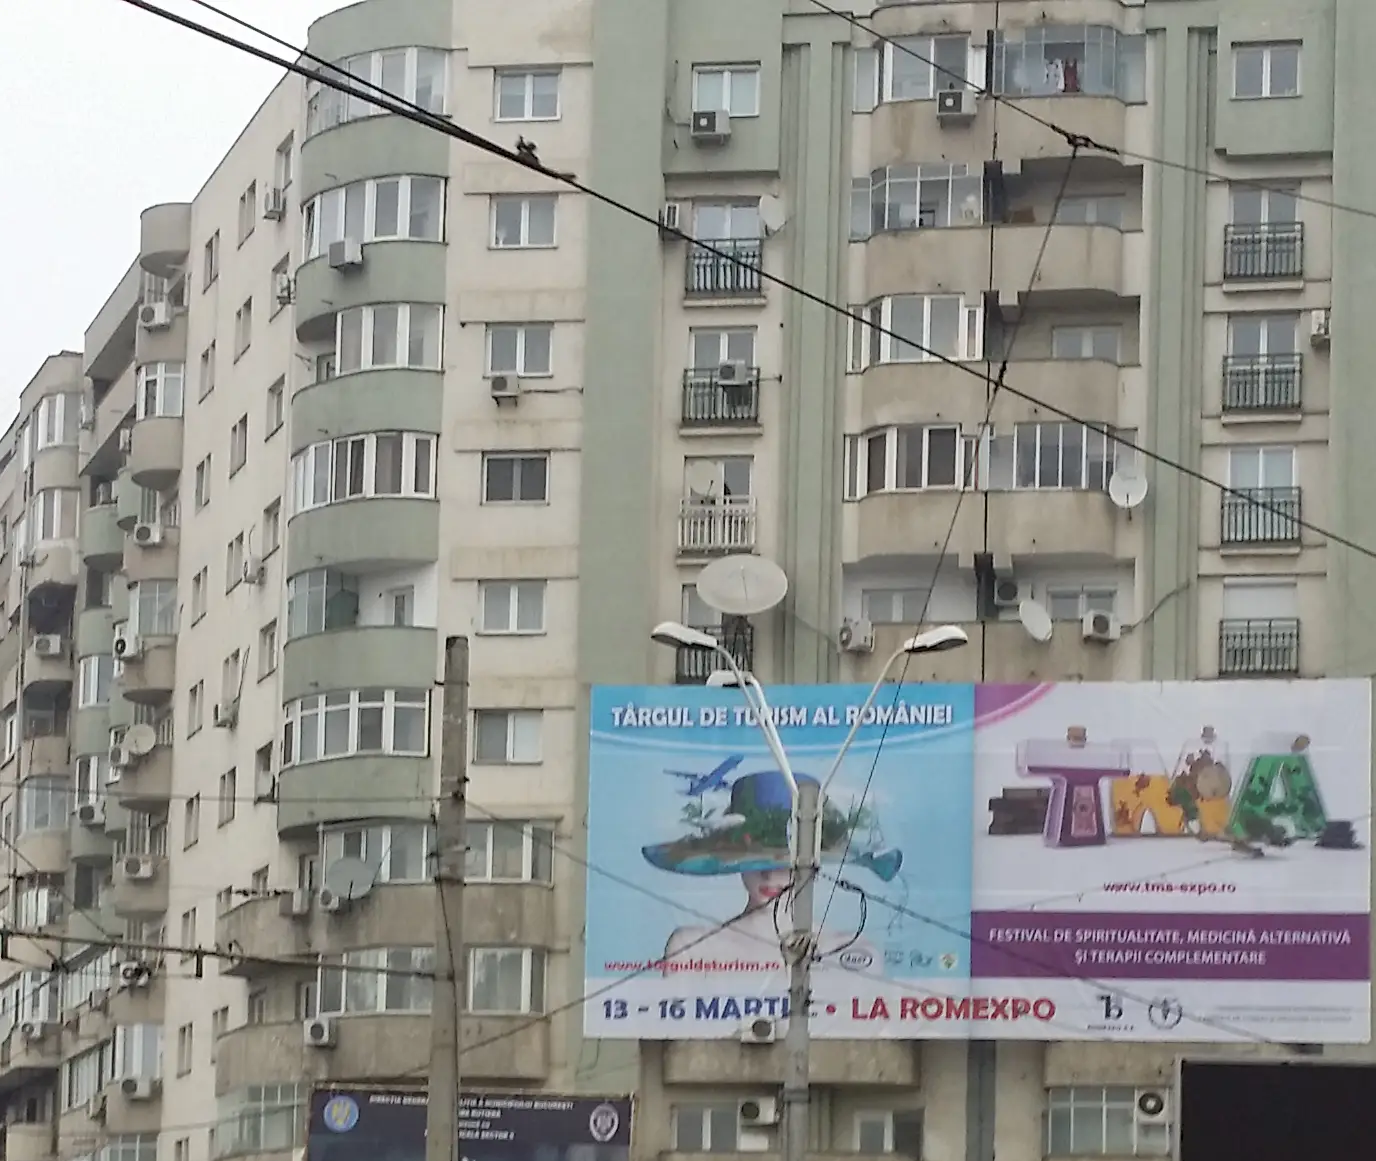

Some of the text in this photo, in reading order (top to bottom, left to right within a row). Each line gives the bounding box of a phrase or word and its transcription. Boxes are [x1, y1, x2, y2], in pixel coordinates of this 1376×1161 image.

[611, 702, 694, 728] TÂRGUL
[700, 706, 728, 727] DE
[812, 704, 841, 726] AL
[845, 699, 953, 726] ROMÂNIEI
[988, 927, 1049, 943] FESTIVAL
[1054, 928, 1072, 943] DE
[1144, 949, 1266, 965] COMPLEMENTARE
[604, 999, 628, 1020] 13
[659, 999, 686, 1020] 16
[695, 997, 814, 1019] MARTI
[852, 997, 889, 1020] LA
[900, 997, 1056, 1021] ROMEXPO
